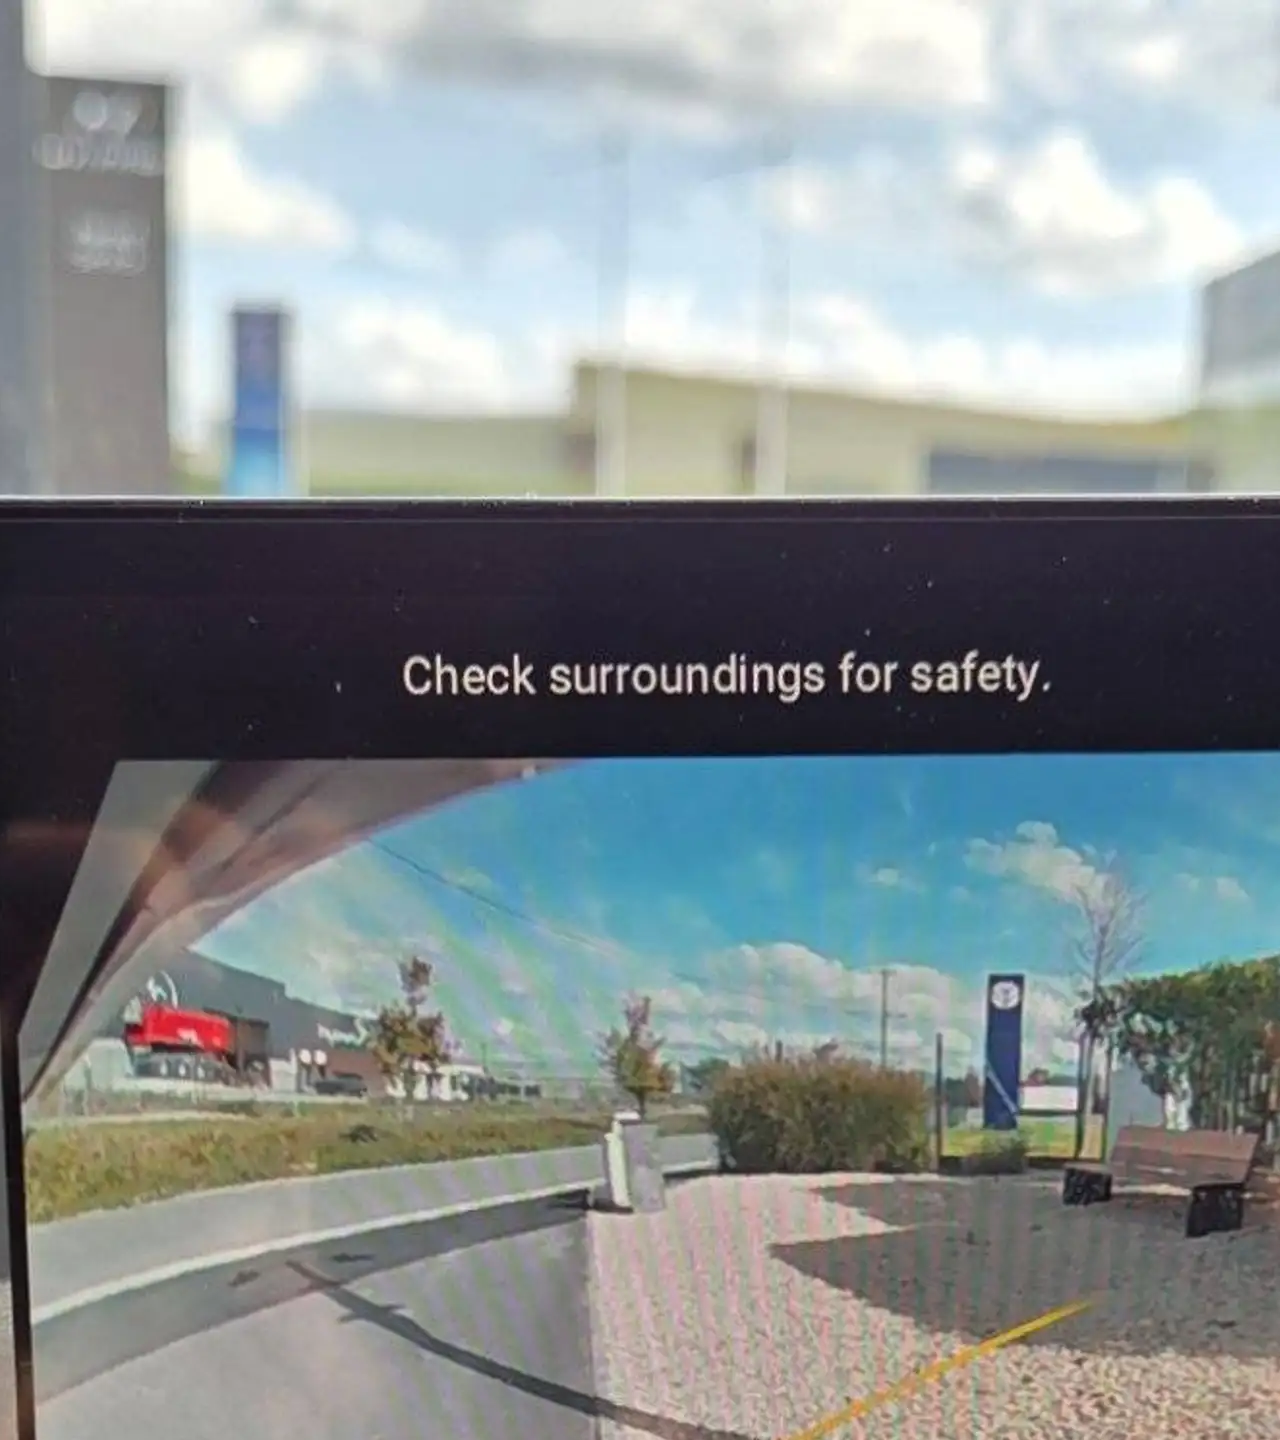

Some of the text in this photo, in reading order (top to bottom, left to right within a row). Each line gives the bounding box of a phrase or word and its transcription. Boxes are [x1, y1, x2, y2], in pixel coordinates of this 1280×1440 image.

[403, 650, 1051, 703] Check surroundings for safety.
